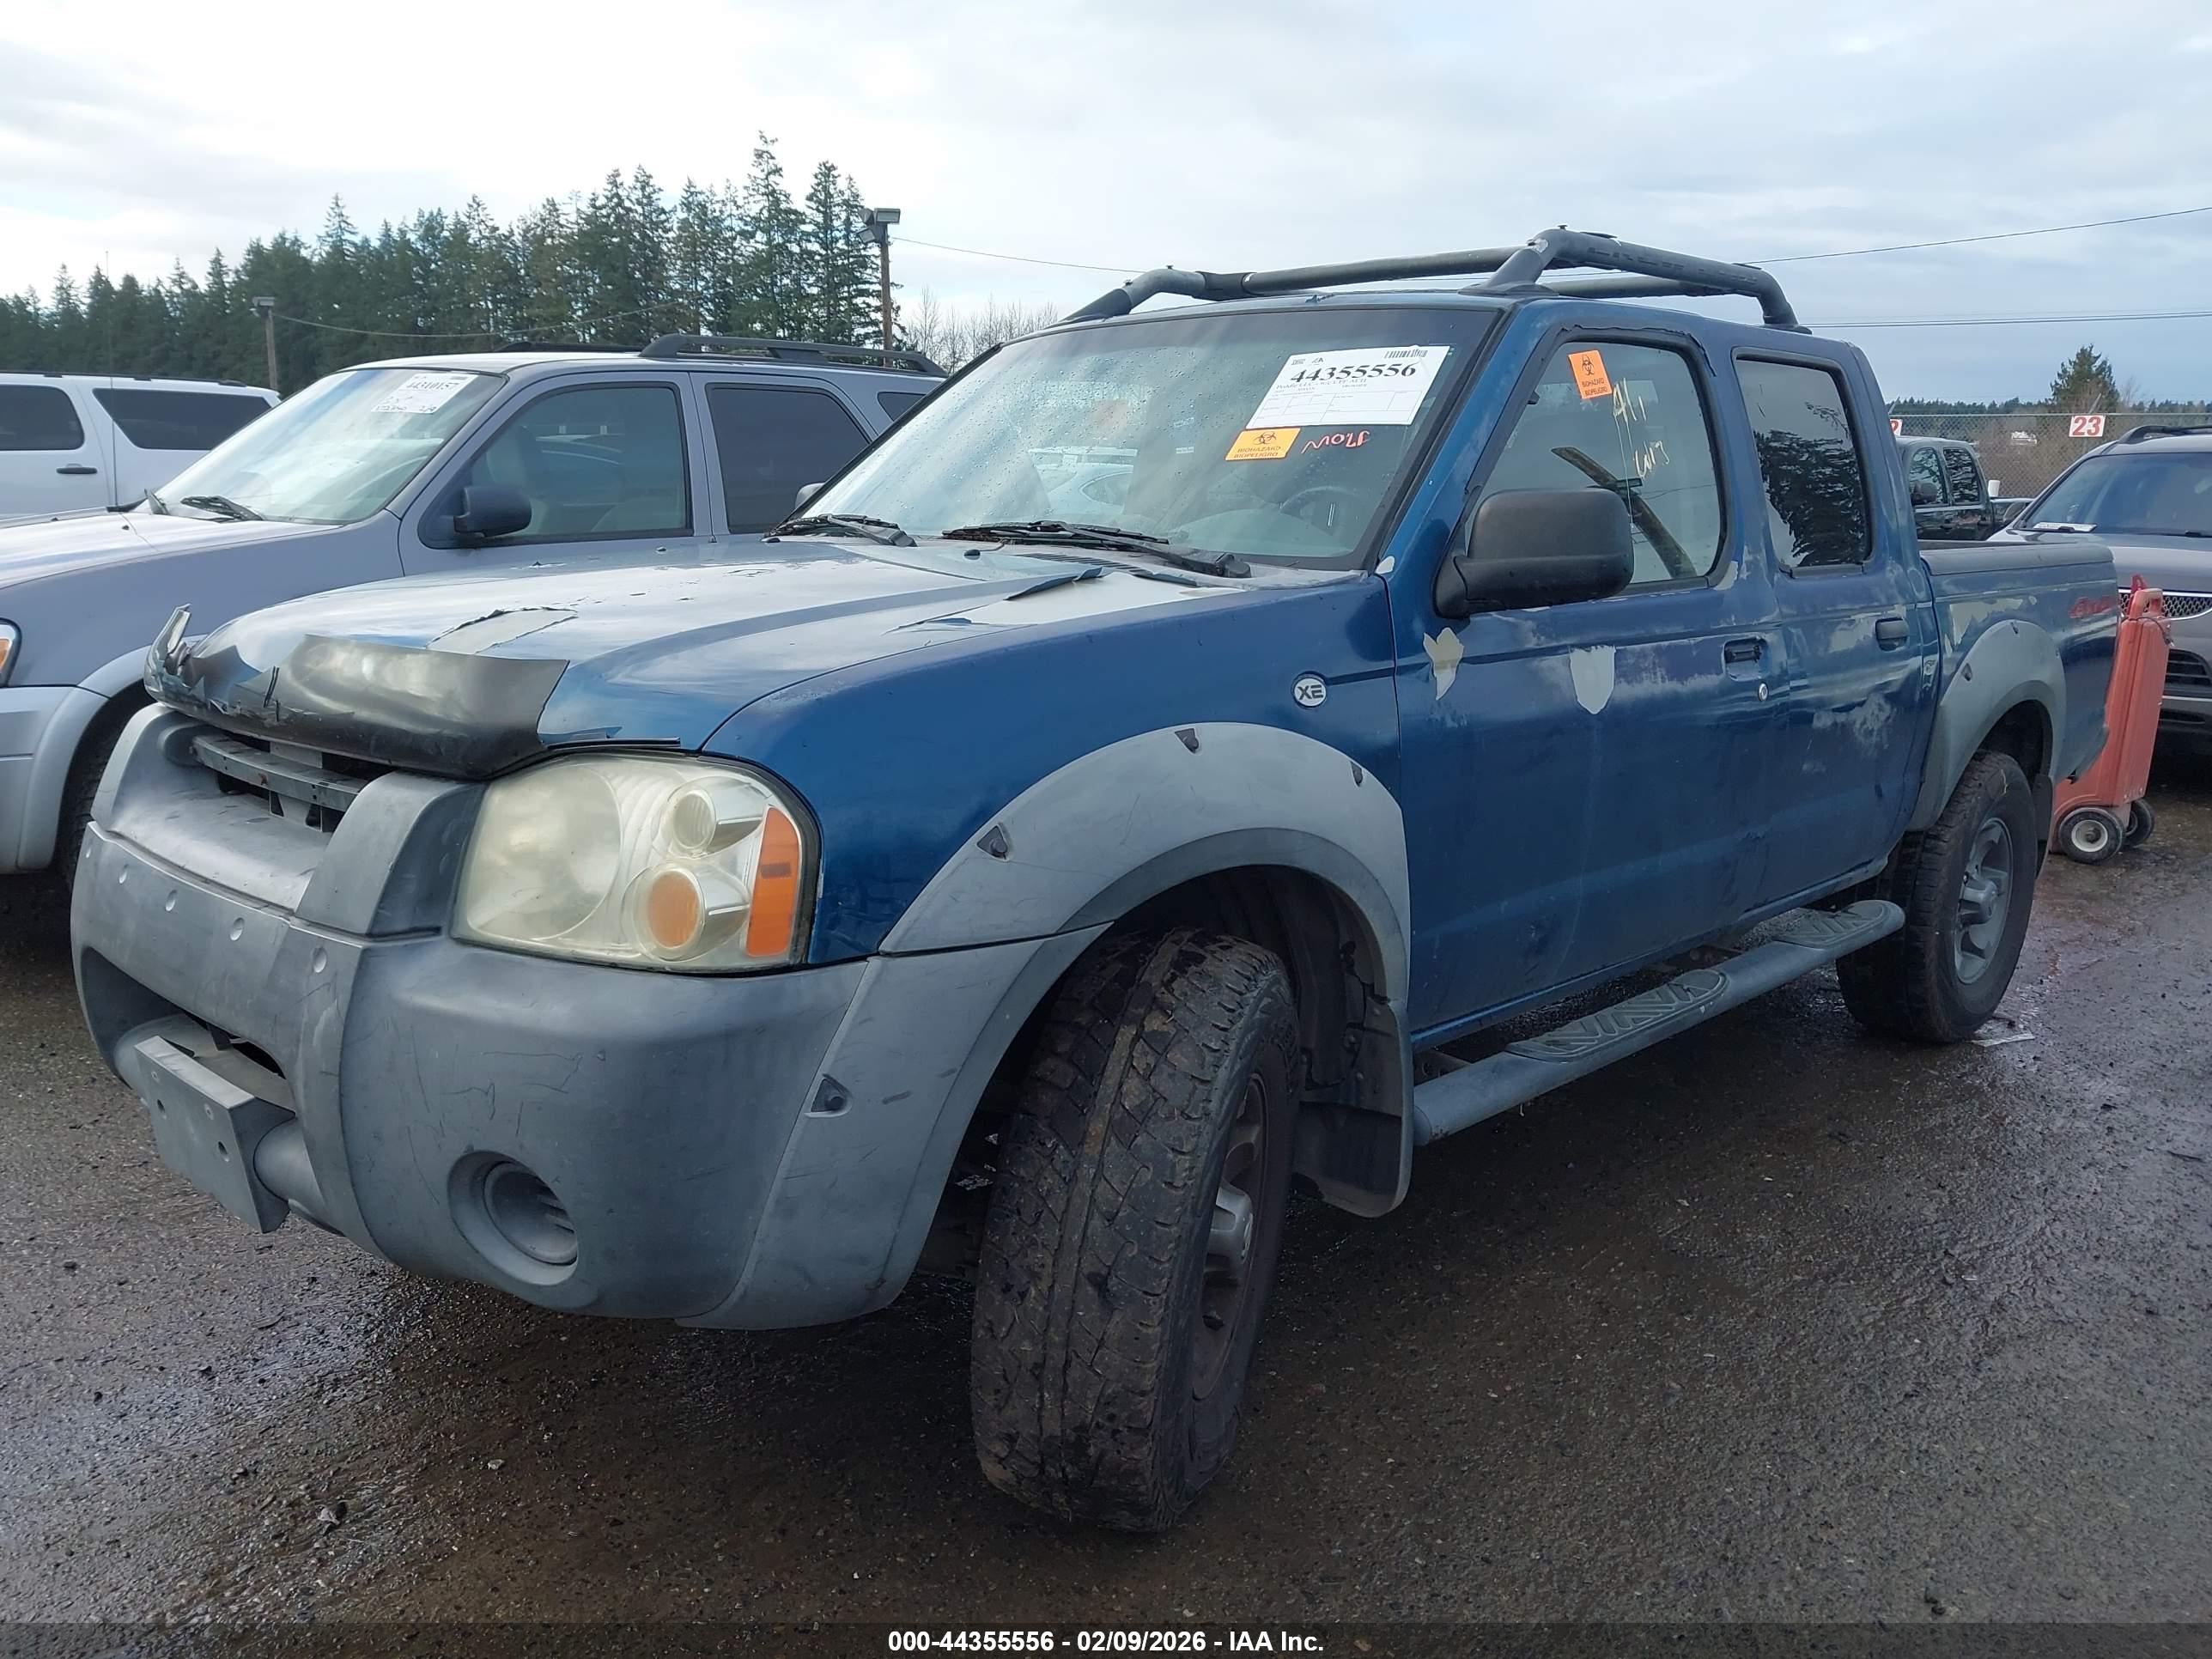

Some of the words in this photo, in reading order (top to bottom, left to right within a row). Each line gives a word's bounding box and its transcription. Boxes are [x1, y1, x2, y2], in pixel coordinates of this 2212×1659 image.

[1291, 361, 1420, 383] 44355556
[2072, 416, 2101, 436] 23
[1297, 684, 1324, 701] XE
